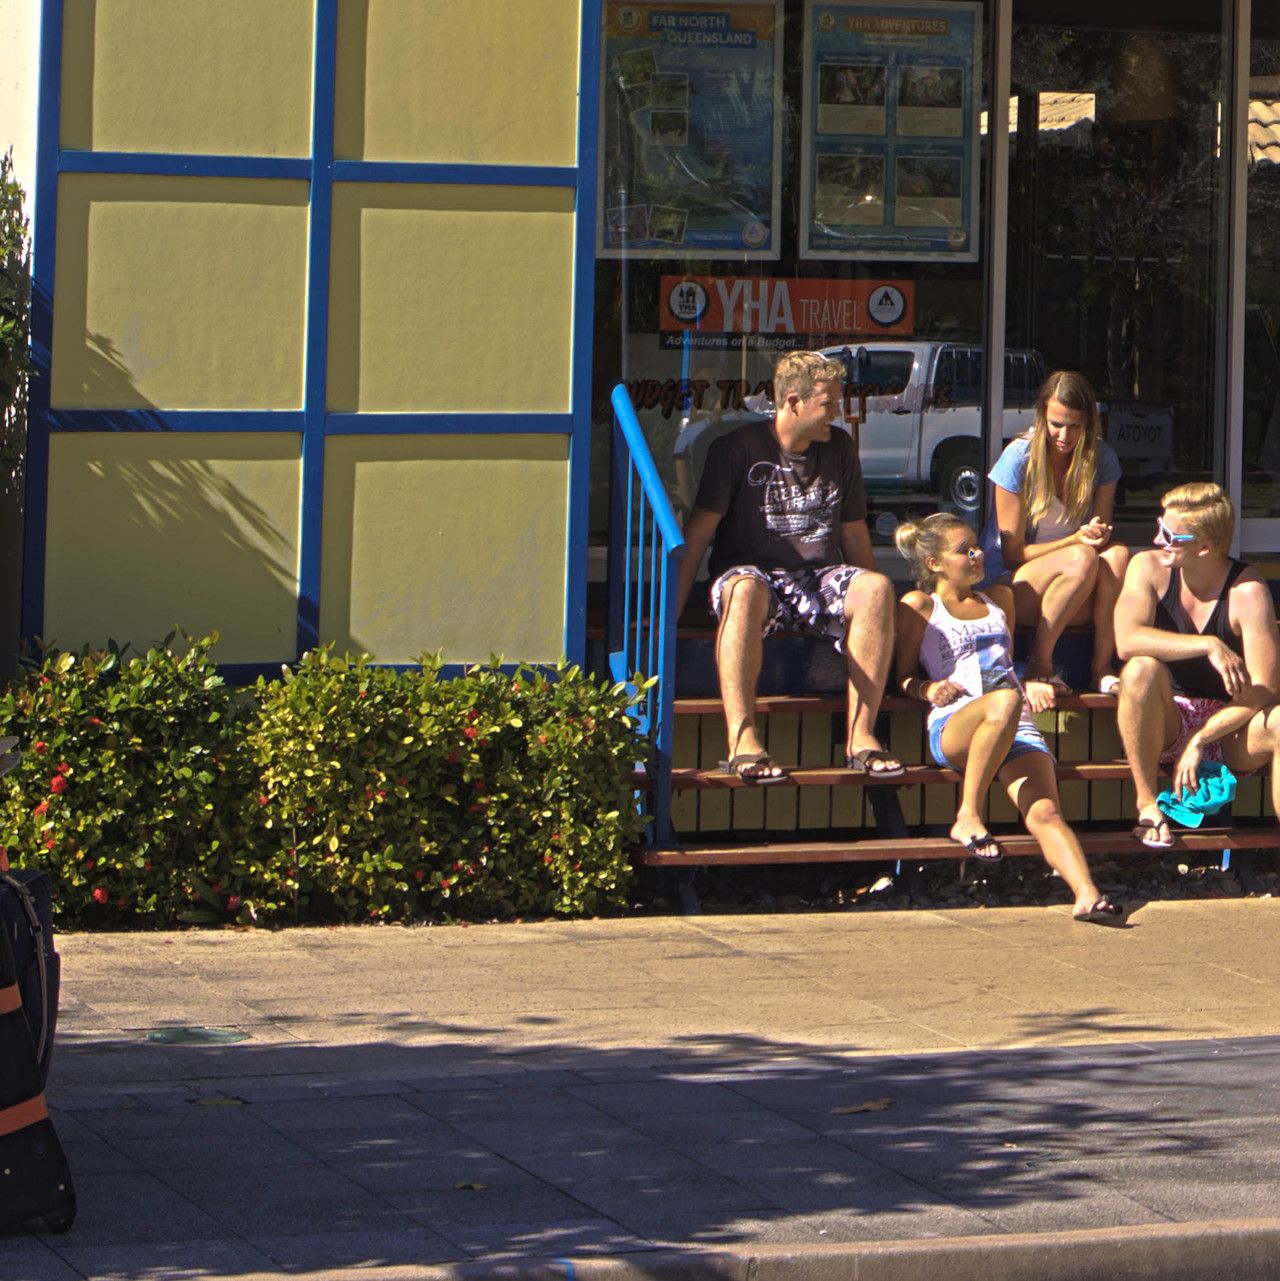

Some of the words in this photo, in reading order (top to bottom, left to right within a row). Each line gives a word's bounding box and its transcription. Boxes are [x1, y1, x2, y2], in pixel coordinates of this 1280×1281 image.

[652, 15, 676, 27] FAR
[678, 16, 726, 28] NORTH
[874, 18, 947, 33] ADVENTURES
[667, 32, 752, 45] QUEENSLAND
[715, 280, 795, 333] YHA
[800, 298, 862, 331] TRAVEL
[666, 335, 728, 346] Adventures
[628, 378, 711, 420] UDGET
